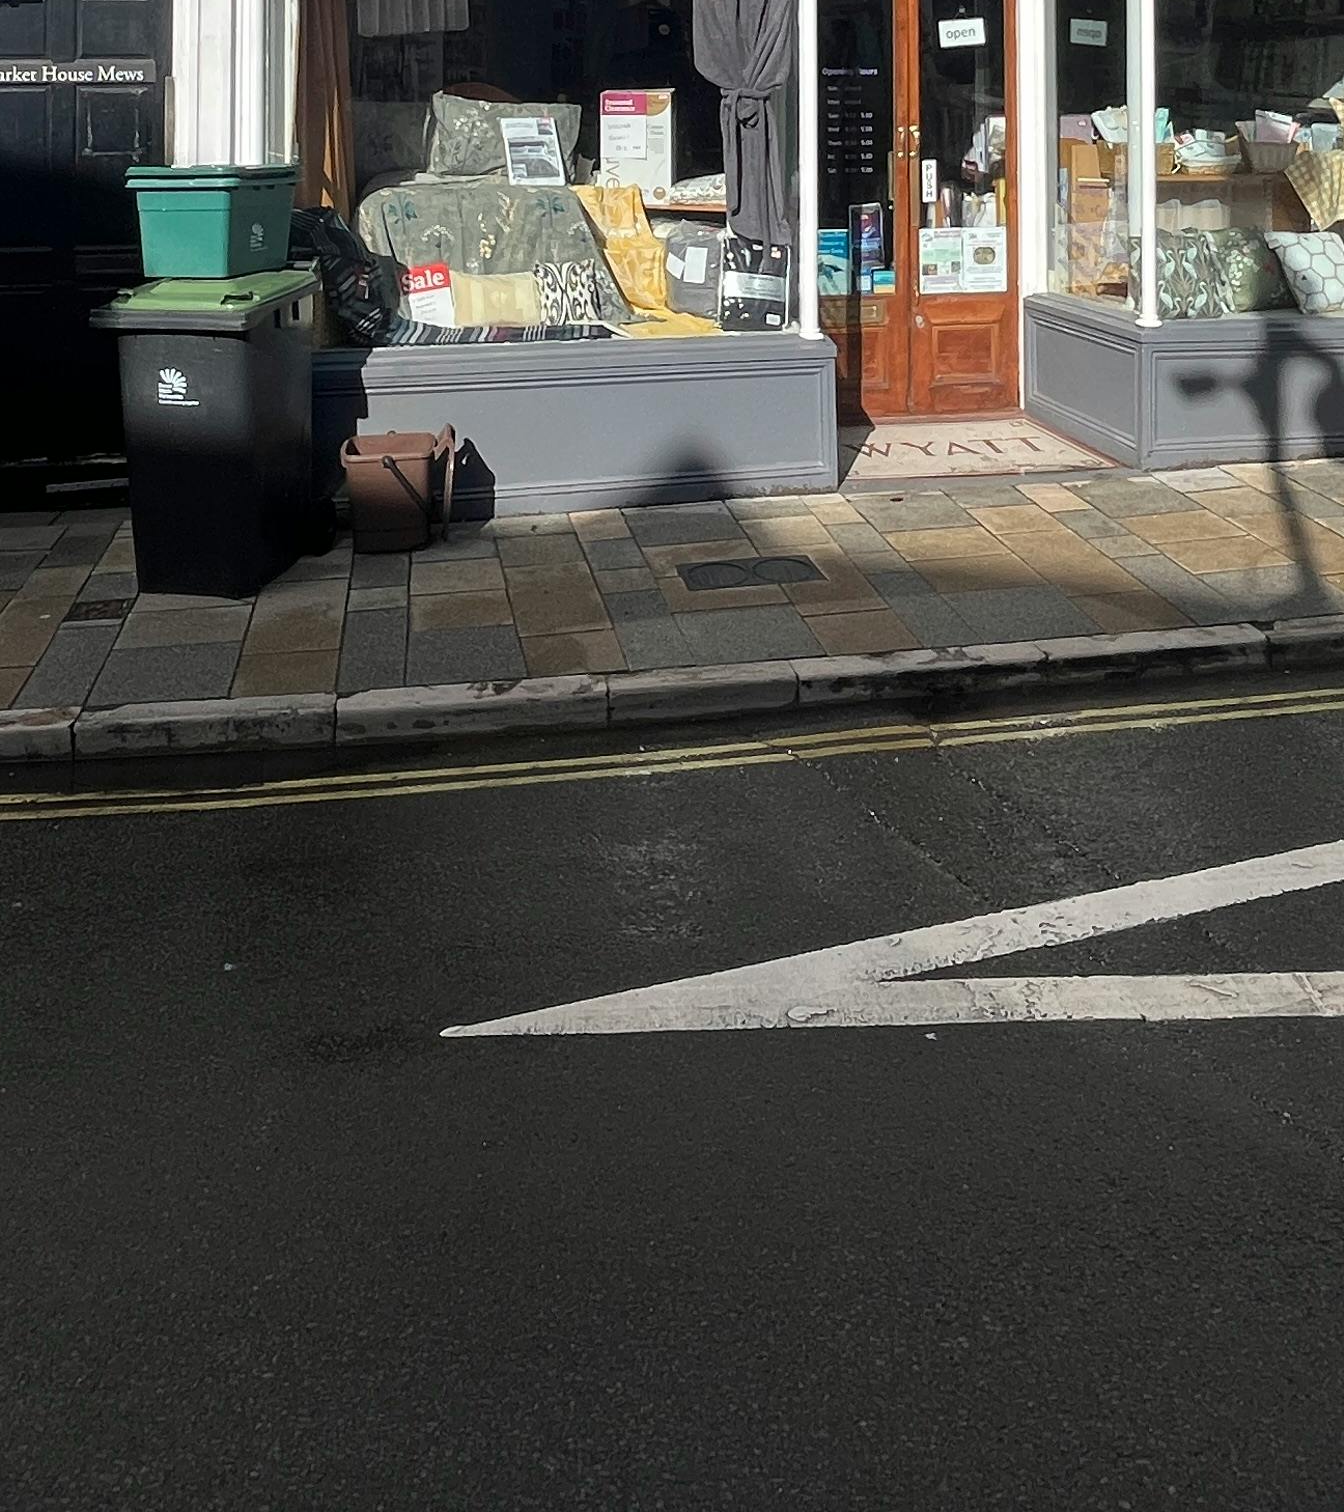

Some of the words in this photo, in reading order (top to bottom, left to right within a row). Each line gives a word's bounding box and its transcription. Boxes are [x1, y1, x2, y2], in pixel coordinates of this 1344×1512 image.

[946, 27, 976, 40] open
[42, 65, 93, 82] House
[97, 65, 144, 82] Mews
[925, 165, 933, 197] PUSH
[401, 269, 445, 292] Sale
[843, 436, 1044, 458] WYATT
